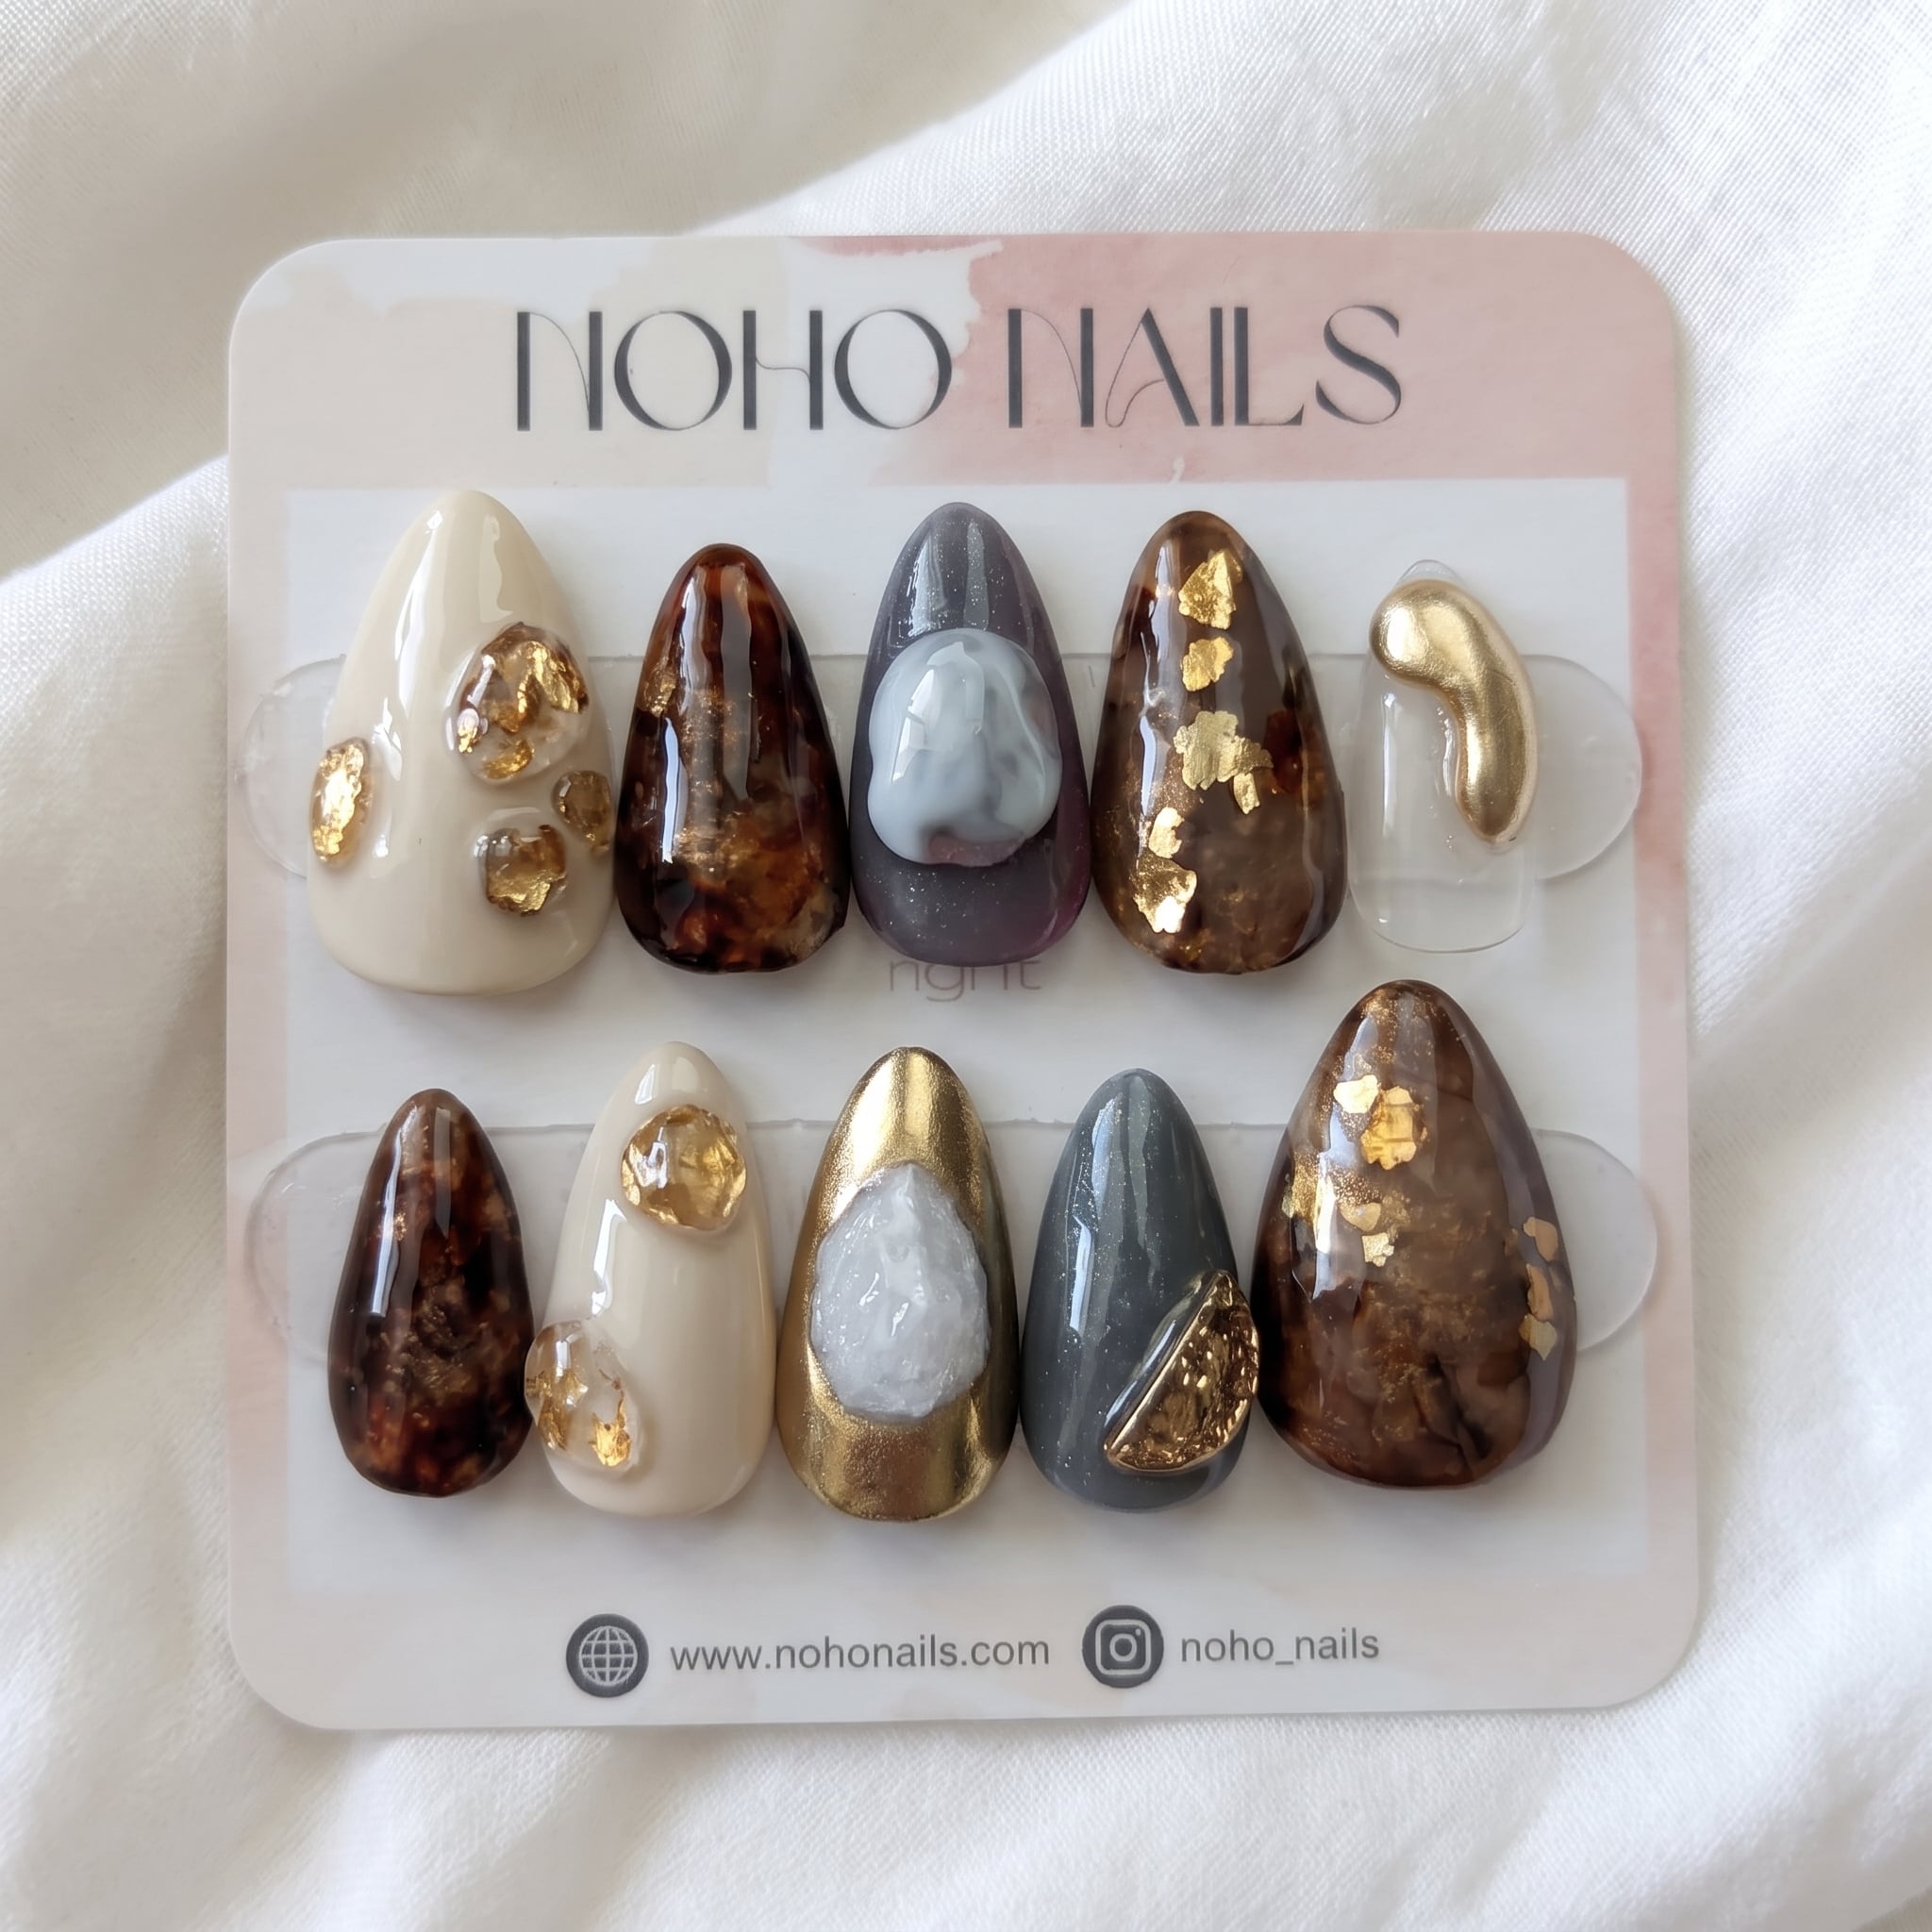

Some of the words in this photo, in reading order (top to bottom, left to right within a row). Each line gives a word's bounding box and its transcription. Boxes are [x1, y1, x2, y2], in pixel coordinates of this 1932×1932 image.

[516, 308, 953, 431] NOHO
[1007, 304, 1403, 429] NAILS
[670, 1634, 1050, 1672] www.nohonails.com
[1181, 1626, 1379, 1666] noho_nails
